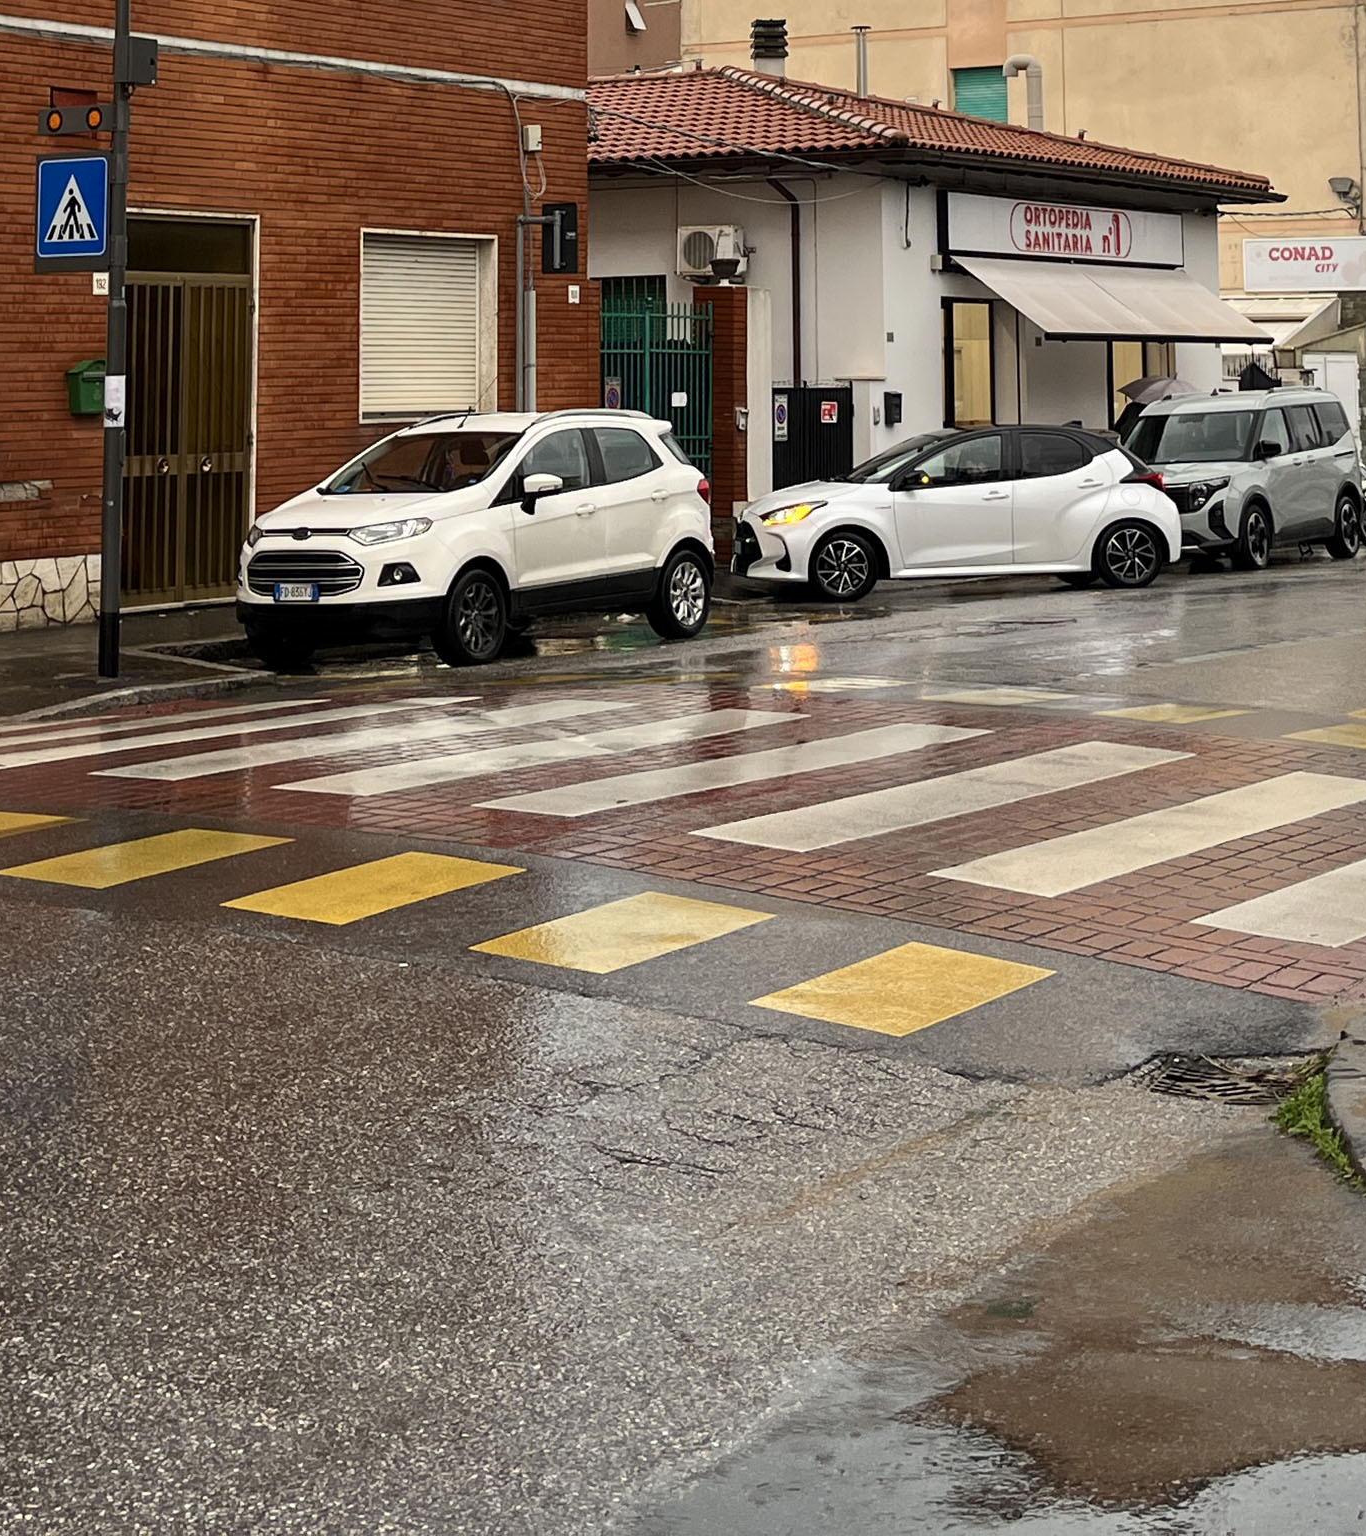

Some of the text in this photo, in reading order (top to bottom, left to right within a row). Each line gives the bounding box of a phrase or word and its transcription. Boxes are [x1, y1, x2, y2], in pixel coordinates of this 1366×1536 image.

[1024, 205, 1092, 231] ORTOPEDIA
[1025, 229, 1092, 253] SANITARIA
[1268, 246, 1333, 261] CONAD
[1315, 264, 1338, 273] CITY
